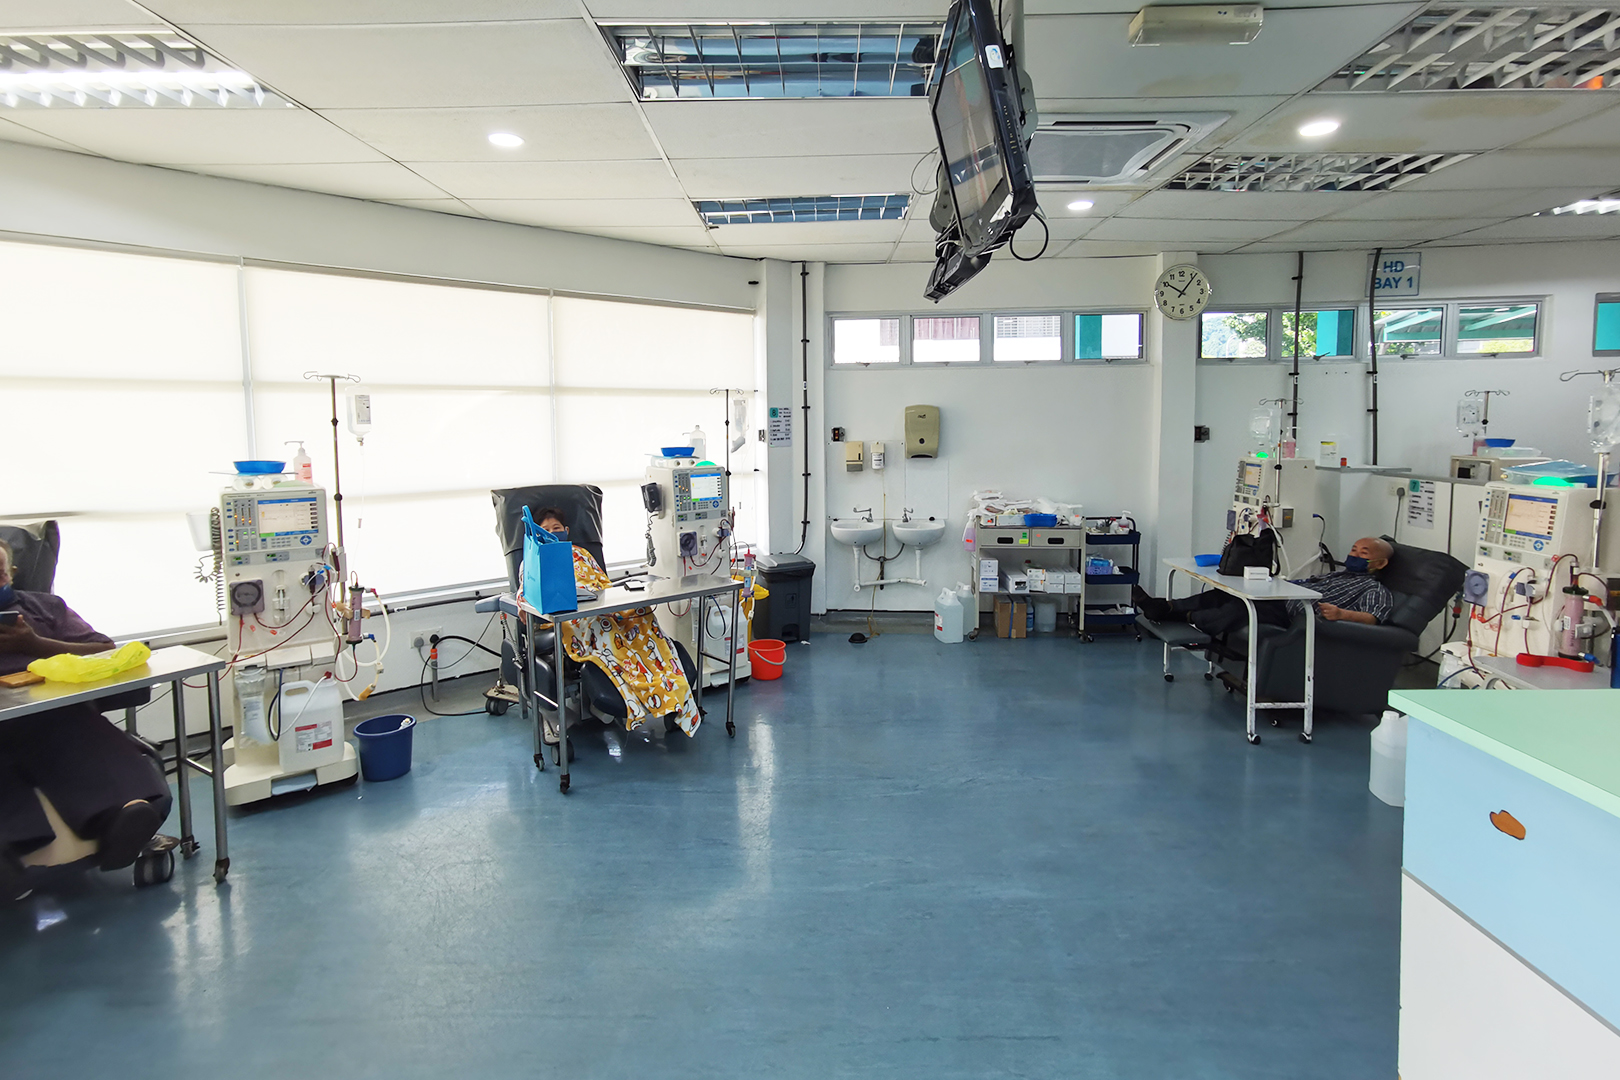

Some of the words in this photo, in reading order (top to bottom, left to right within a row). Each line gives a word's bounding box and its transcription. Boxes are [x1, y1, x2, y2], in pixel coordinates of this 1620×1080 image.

[1383, 260, 1405, 273] HD
[1169, 273, 1175, 281] 11
[1178, 270, 1186, 278] 12
[1196, 279, 1202, 287] 2
[1374, 276, 1402, 290] BAY
[1406, 276, 1413, 289] 1
[1159, 290, 1165, 298] 9
[1162, 299, 1168, 307] 8
[1195, 297, 1202, 305] 4
[1170, 305, 1176, 313] 7
[1179, 307, 1185, 315] 6
[1189, 304, 1195, 312] 5
[1412, 481, 1417, 489] 7
